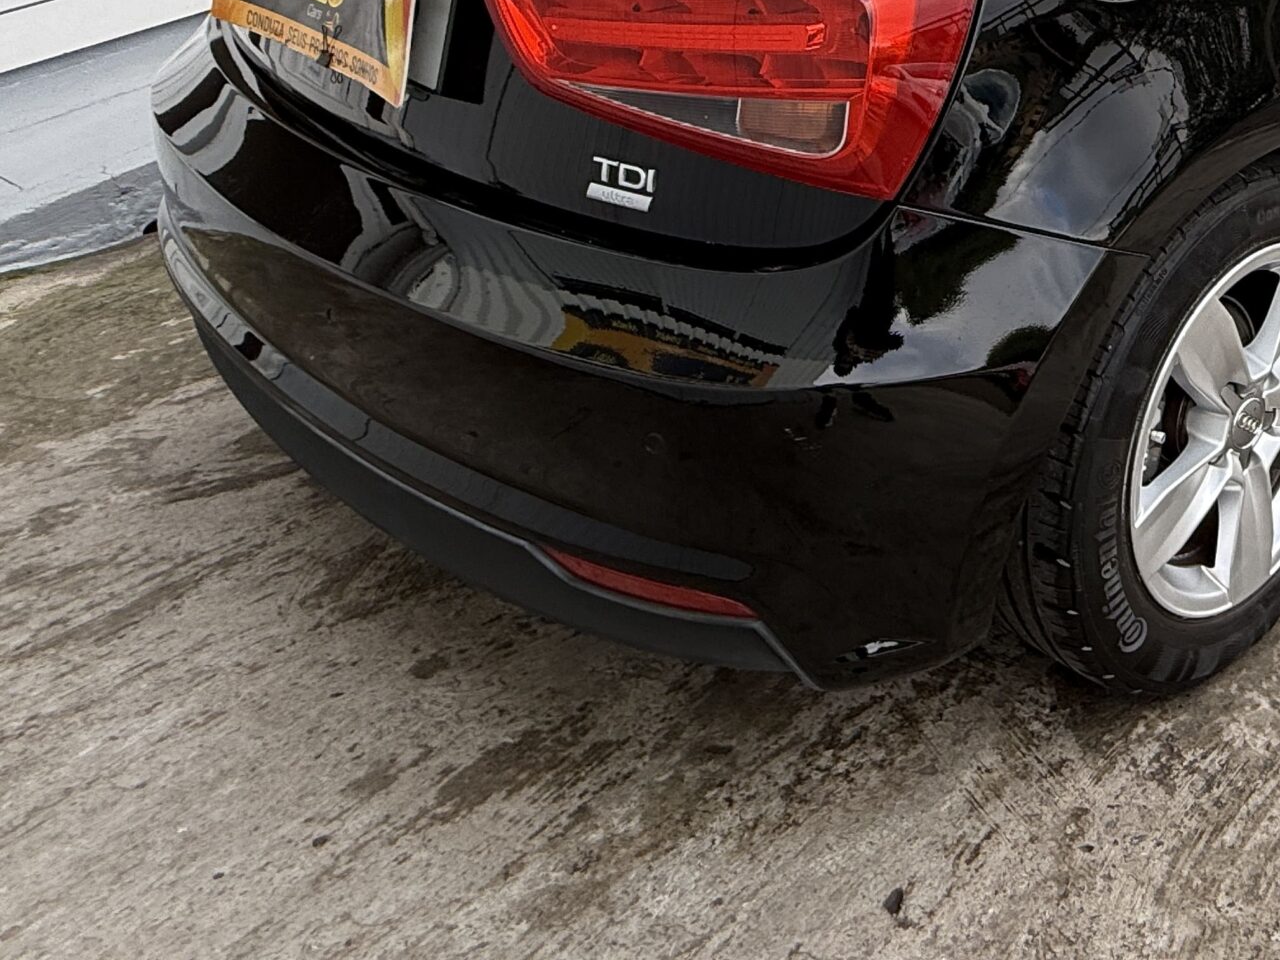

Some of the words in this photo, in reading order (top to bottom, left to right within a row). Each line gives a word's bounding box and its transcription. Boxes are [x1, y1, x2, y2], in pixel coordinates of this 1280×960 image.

[246, 10, 285, 37] CONDUZA
[288, 26, 308, 49] SEUS
[593, 156, 656, 193] TDI
[601, 190, 634, 206] ultra
